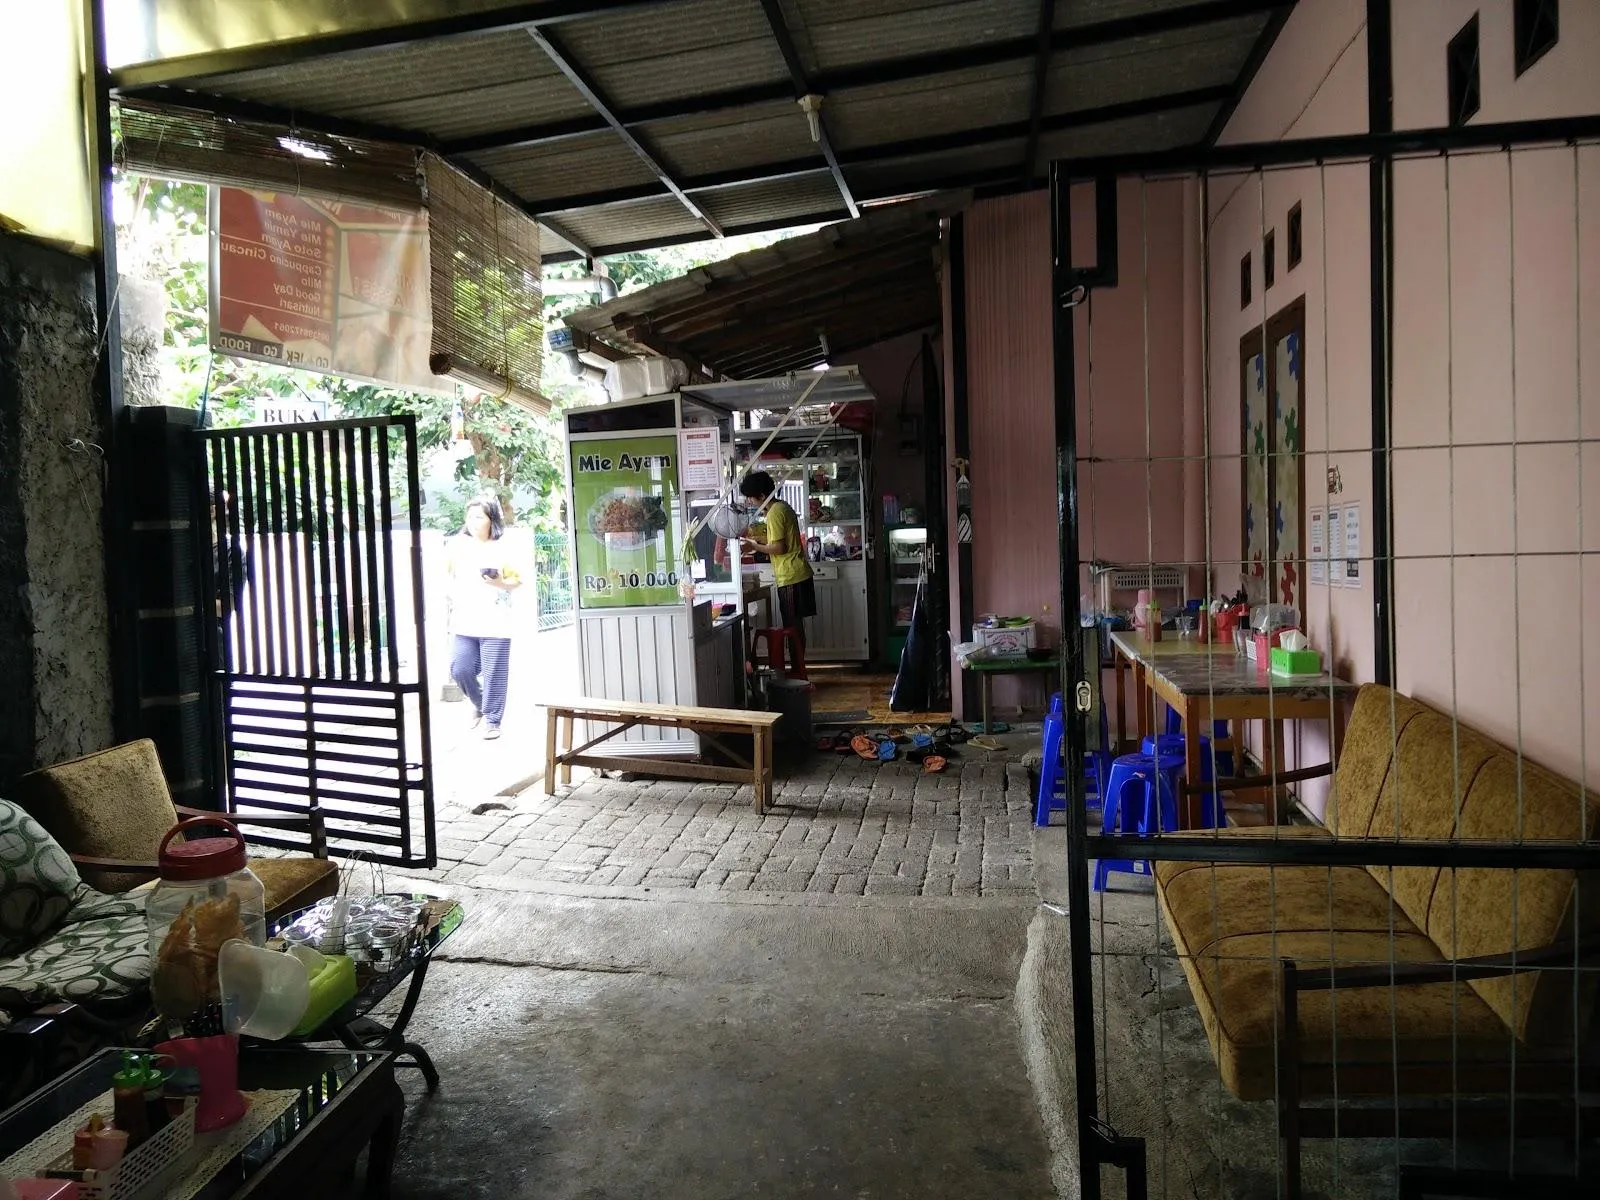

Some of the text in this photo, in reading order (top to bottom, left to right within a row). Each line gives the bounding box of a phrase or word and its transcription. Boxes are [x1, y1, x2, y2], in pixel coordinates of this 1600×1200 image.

[263, 409, 320, 423] BUKA
[579, 453, 671, 472] Mie Ayam
[584, 572, 679, 592] Rp. 10.000
